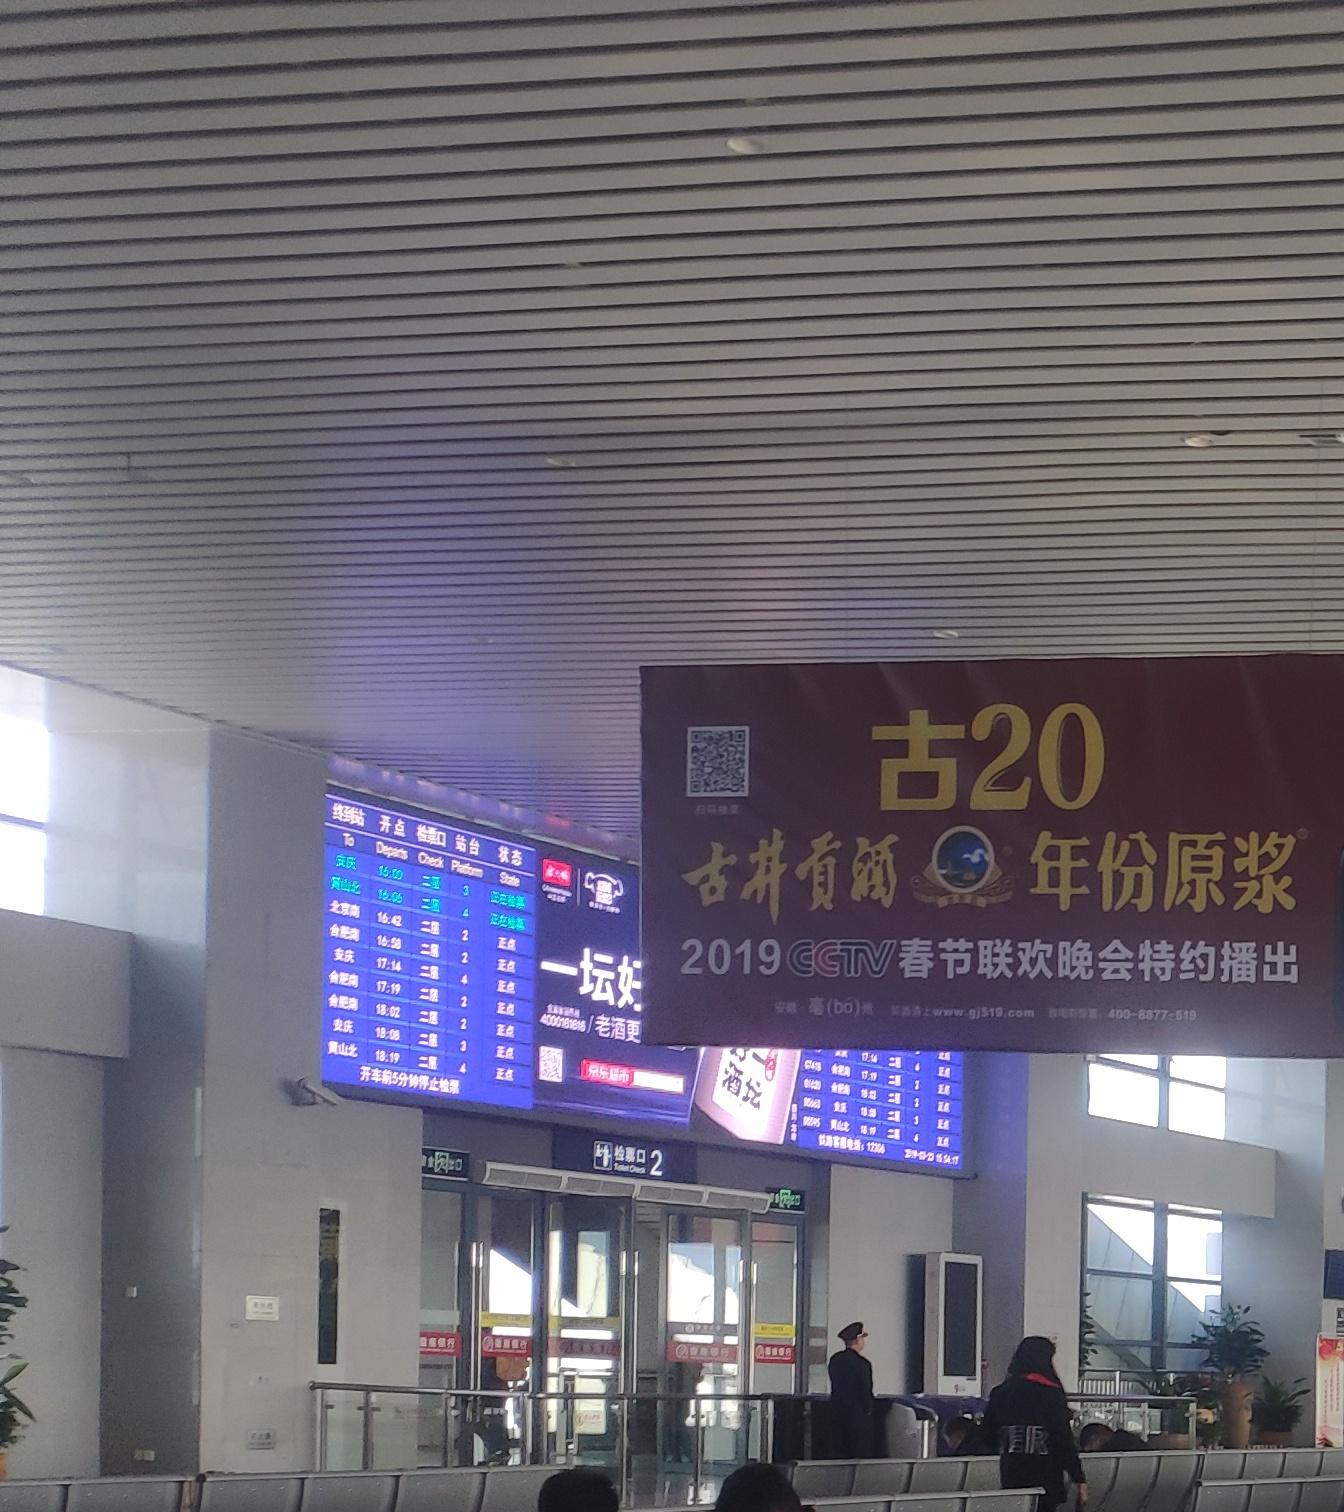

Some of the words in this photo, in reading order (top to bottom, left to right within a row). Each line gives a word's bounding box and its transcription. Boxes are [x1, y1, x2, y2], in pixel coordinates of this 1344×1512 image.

[871, 702, 1105, 811] 古20
[379, 815, 406, 838] 开点
[455, 835, 481, 856] 站台
[498, 846, 523, 866] 状态
[1029, 830, 1297, 914] 年份原浆
[461, 952, 469, 964] 2
[460, 974, 468, 985] 4
[461, 996, 468, 1008] 2
[460, 1018, 467, 1030] 2
[459, 1062, 466, 1074] 4
[614, 1144, 646, 1164] 检票口
[650, 1149, 663, 1176] 2
